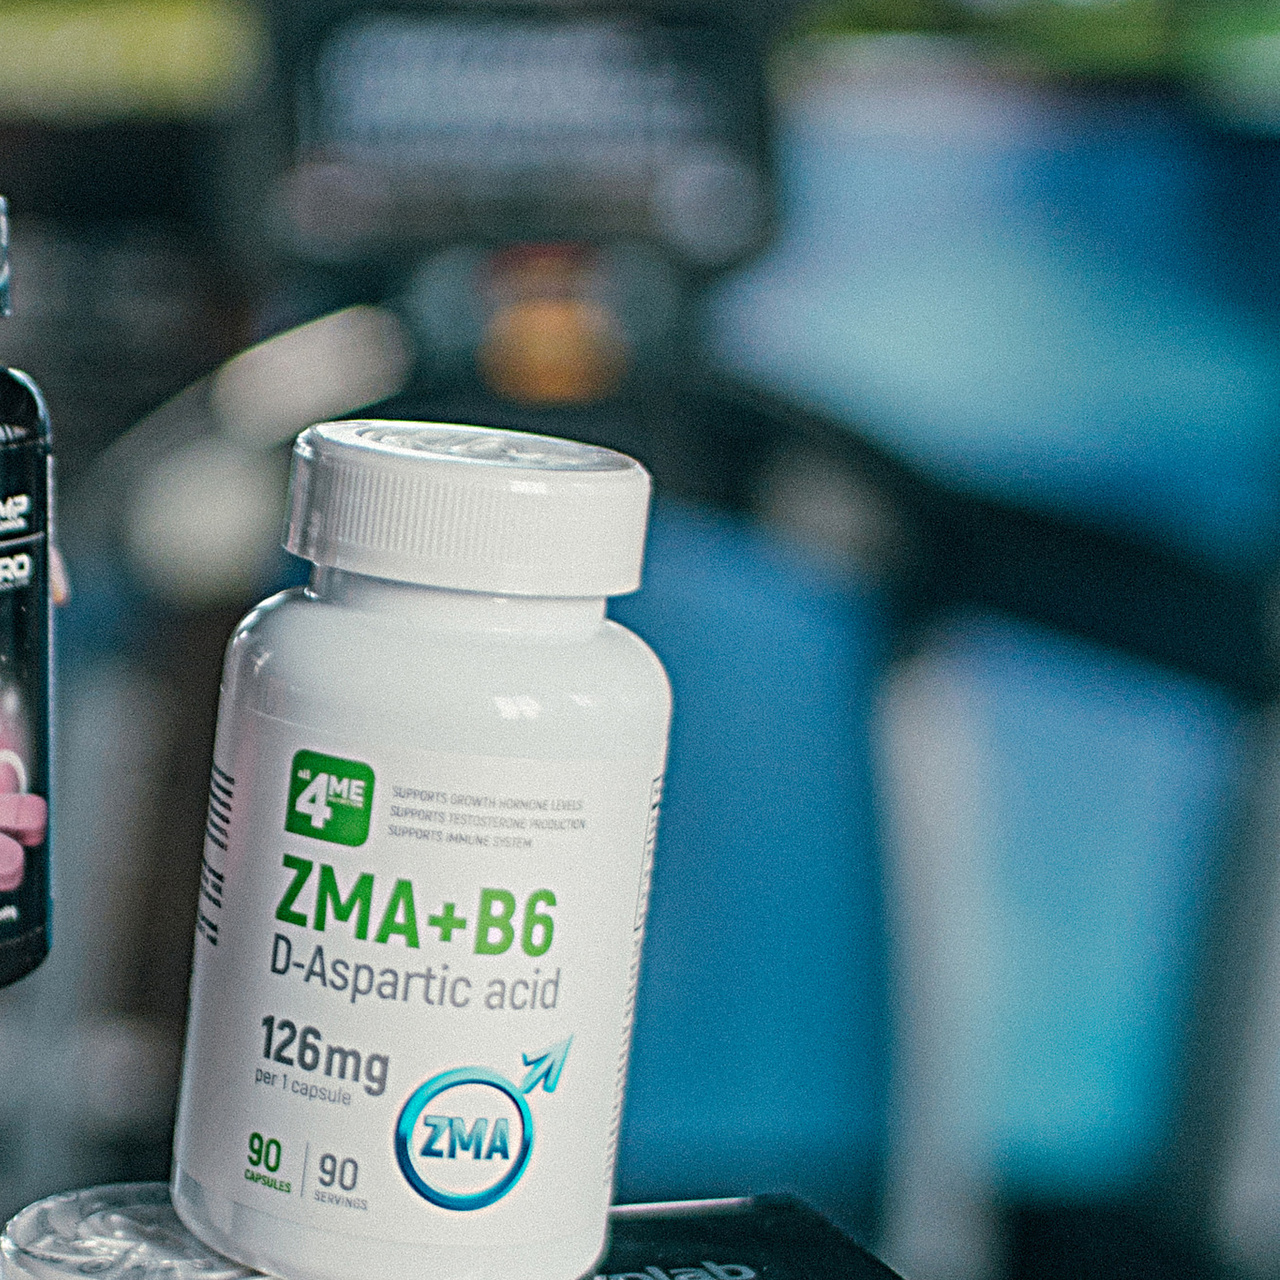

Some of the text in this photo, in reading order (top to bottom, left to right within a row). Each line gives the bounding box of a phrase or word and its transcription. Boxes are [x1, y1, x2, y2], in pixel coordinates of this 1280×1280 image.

[390, 805, 586, 831] SUPPORTS TESTOSTERONE PRODUCTION
[392, 786, 584, 811] SUPPORTS GROWTH HORMONE LEVELS
[388, 825, 533, 848] SUPPORTS IMMUNE SYSTEM
[275, 853, 557, 957] ZMA+B6
[271, 932, 561, 1010] D-Aspartic acid
[255, 1067, 352, 1106] per 1 capsule
[247, 1131, 282, 1173] 90
[421, 1115, 510, 1160] ZMA
[244, 1168, 291, 1194] CAPSULES
[318, 1152, 359, 1191] 90
[314, 1190, 368, 1211] SERVINGS
